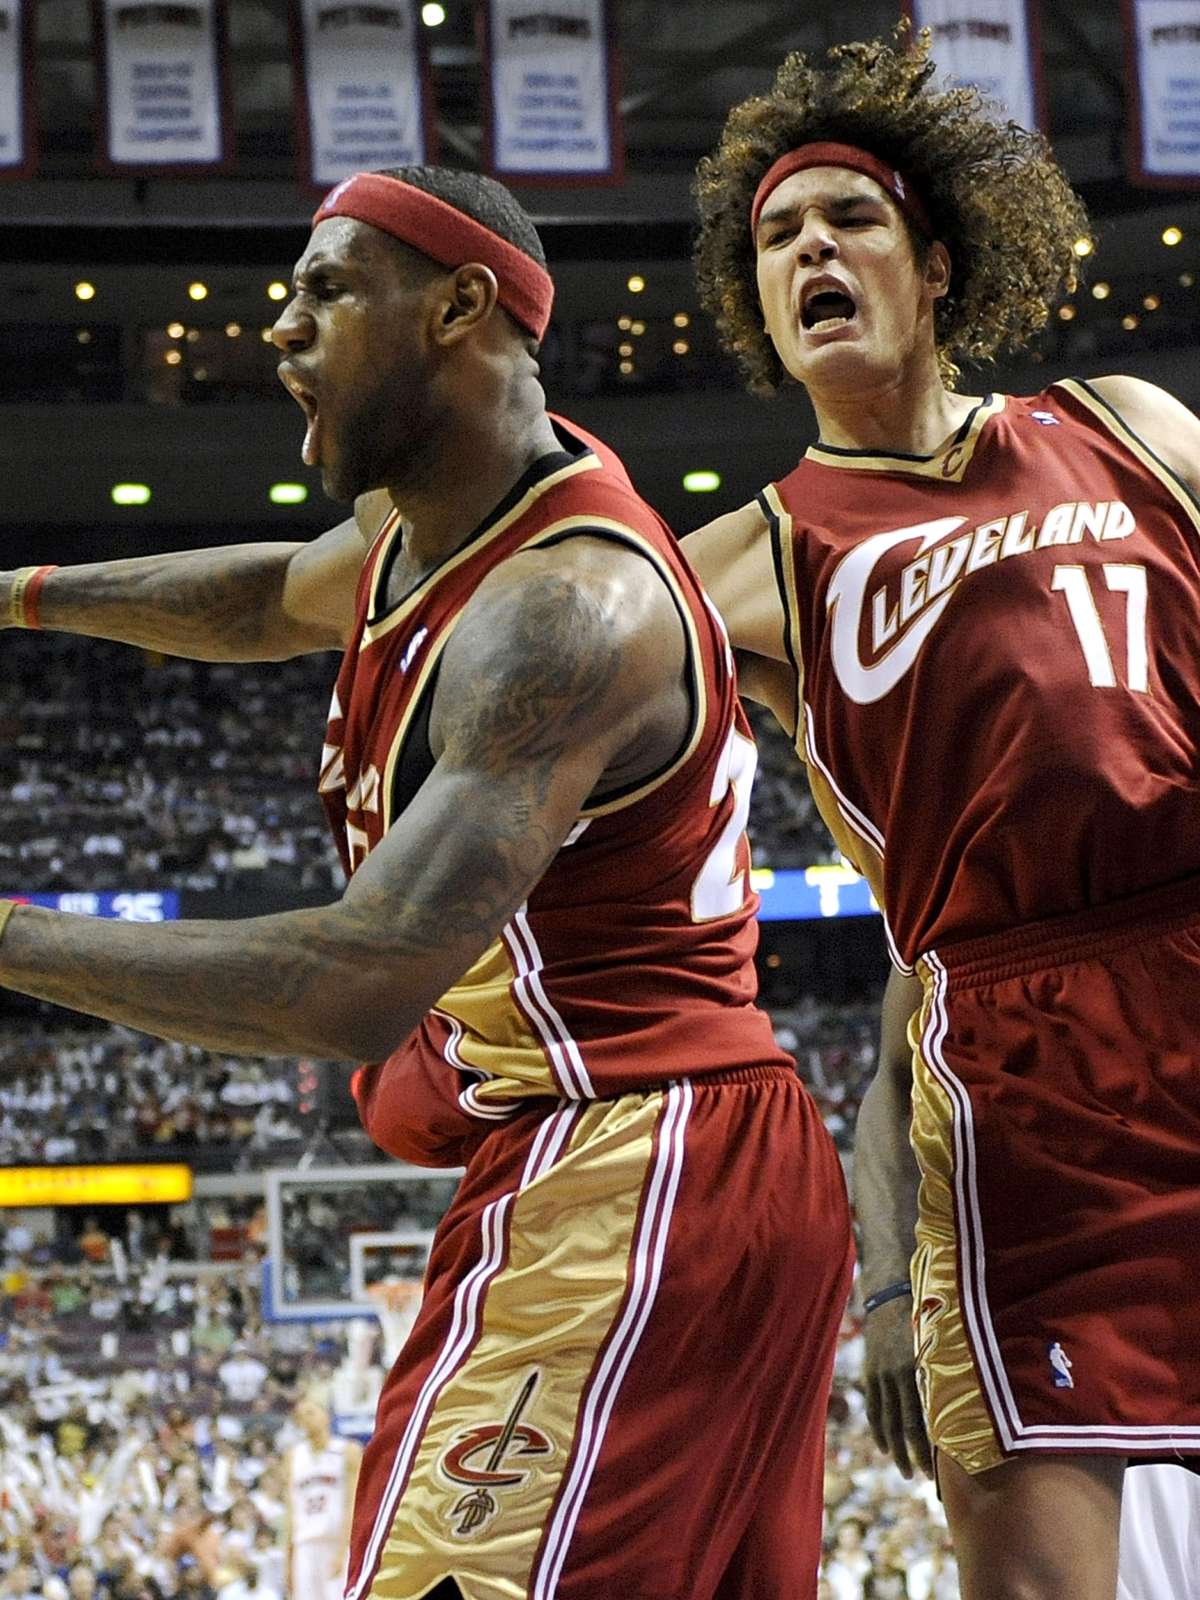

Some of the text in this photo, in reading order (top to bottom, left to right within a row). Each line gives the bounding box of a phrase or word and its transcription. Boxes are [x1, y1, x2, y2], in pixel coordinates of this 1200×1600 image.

[942, 447, 964, 478] C
[825, 500, 1137, 706] CLEVELAND
[1050, 563, 1154, 697] 17
